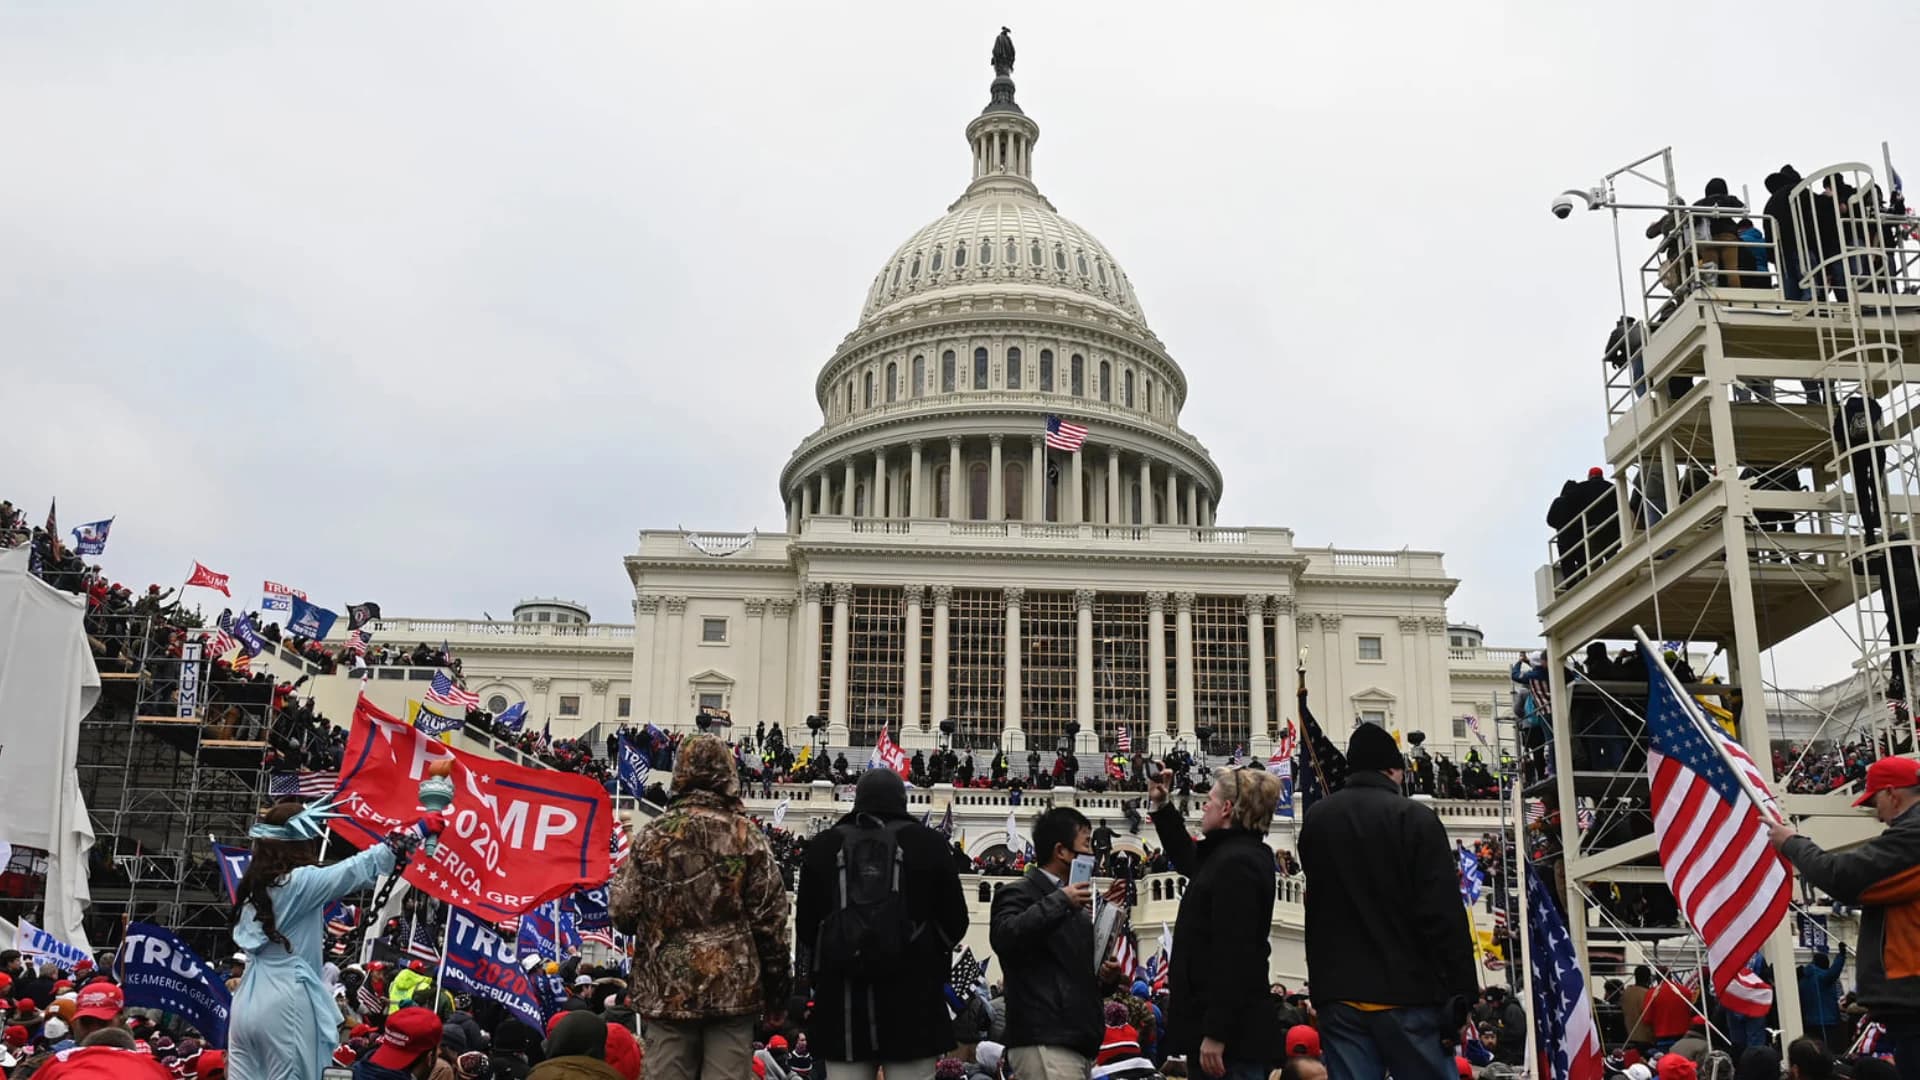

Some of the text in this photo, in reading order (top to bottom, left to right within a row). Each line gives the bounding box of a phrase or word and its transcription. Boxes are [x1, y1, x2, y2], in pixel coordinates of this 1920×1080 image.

[180, 646, 198, 718] TRUMP
[343, 791, 535, 908] KEEP ERICA GRE
[32, 929, 89, 962] TRUM
[123, 933, 204, 979] TRU
[454, 912, 518, 964] TRU
[141, 974, 188, 995] AMERICA
[189, 988, 215, 1010] GREAT
[446, 965, 464, 980] NO
[474, 957, 528, 996] 2020
